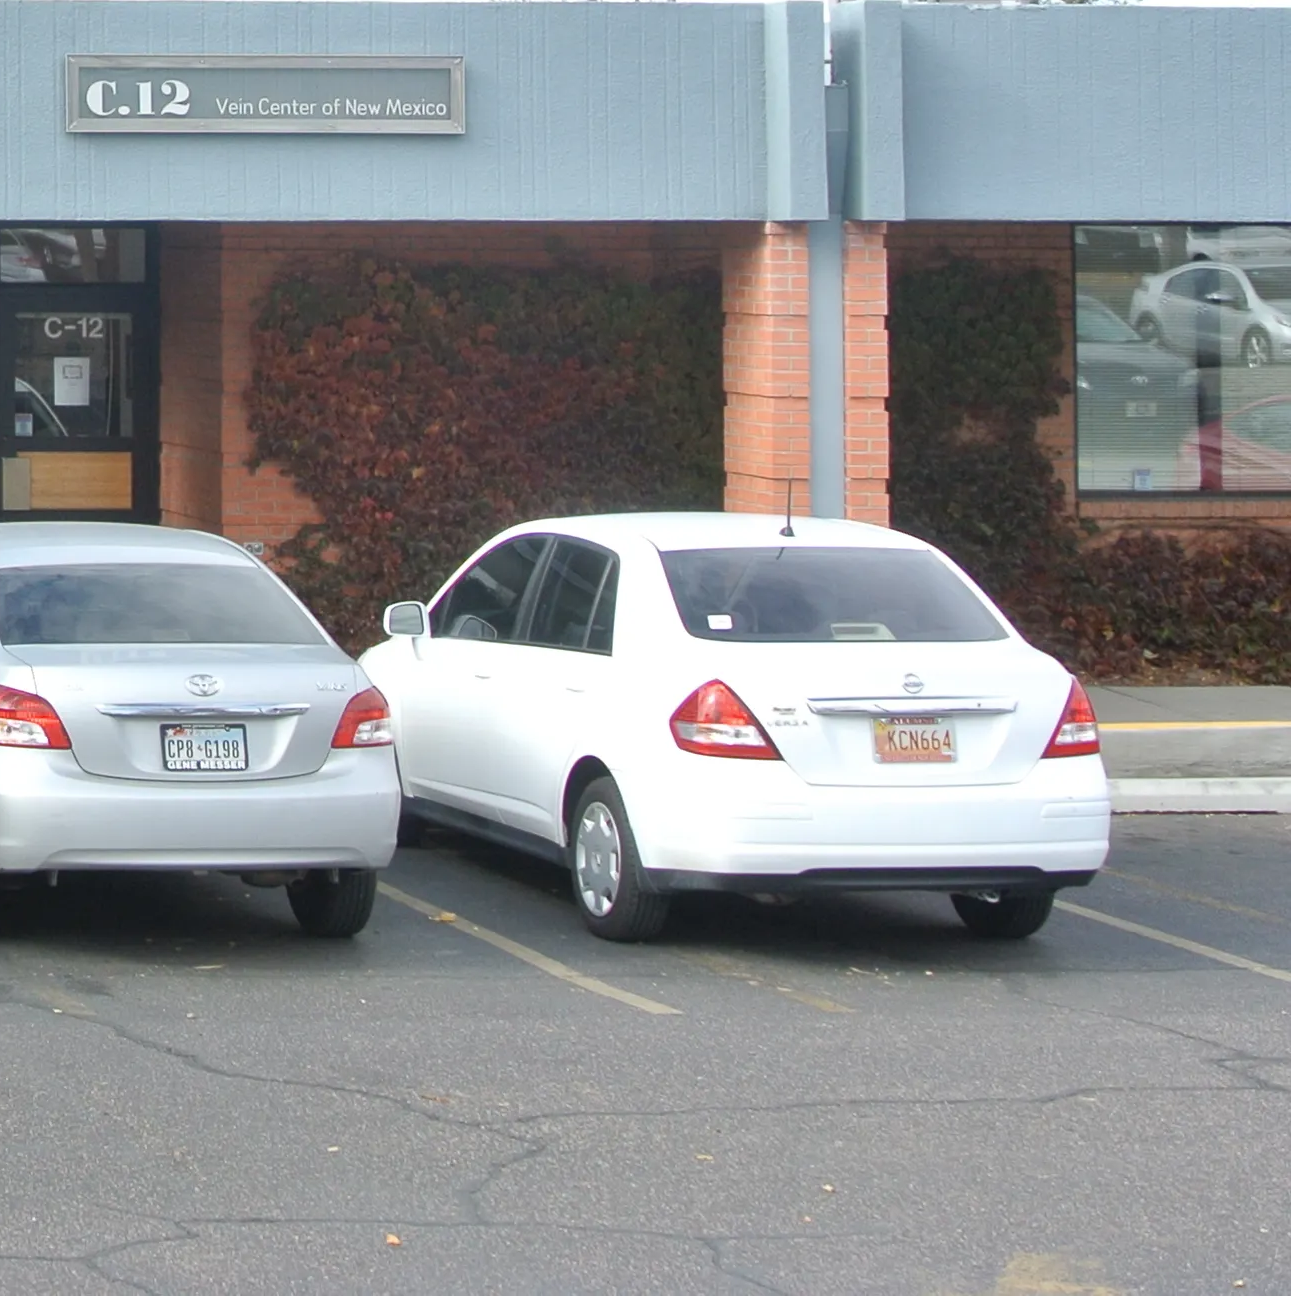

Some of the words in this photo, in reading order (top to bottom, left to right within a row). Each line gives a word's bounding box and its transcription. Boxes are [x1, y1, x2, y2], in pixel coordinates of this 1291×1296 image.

[86, 79, 190, 116] C.12
[216, 97, 253, 115] Vein
[258, 98, 315, 115] Center
[322, 98, 341, 115] of
[346, 99, 381, 115] New
[385, 98, 447, 116] Mexico
[43, 316, 104, 339] C-12
[887, 729, 952, 751] KCN664
[167, 760, 198, 770] GENE
[200, 760, 246, 770] MESSER
